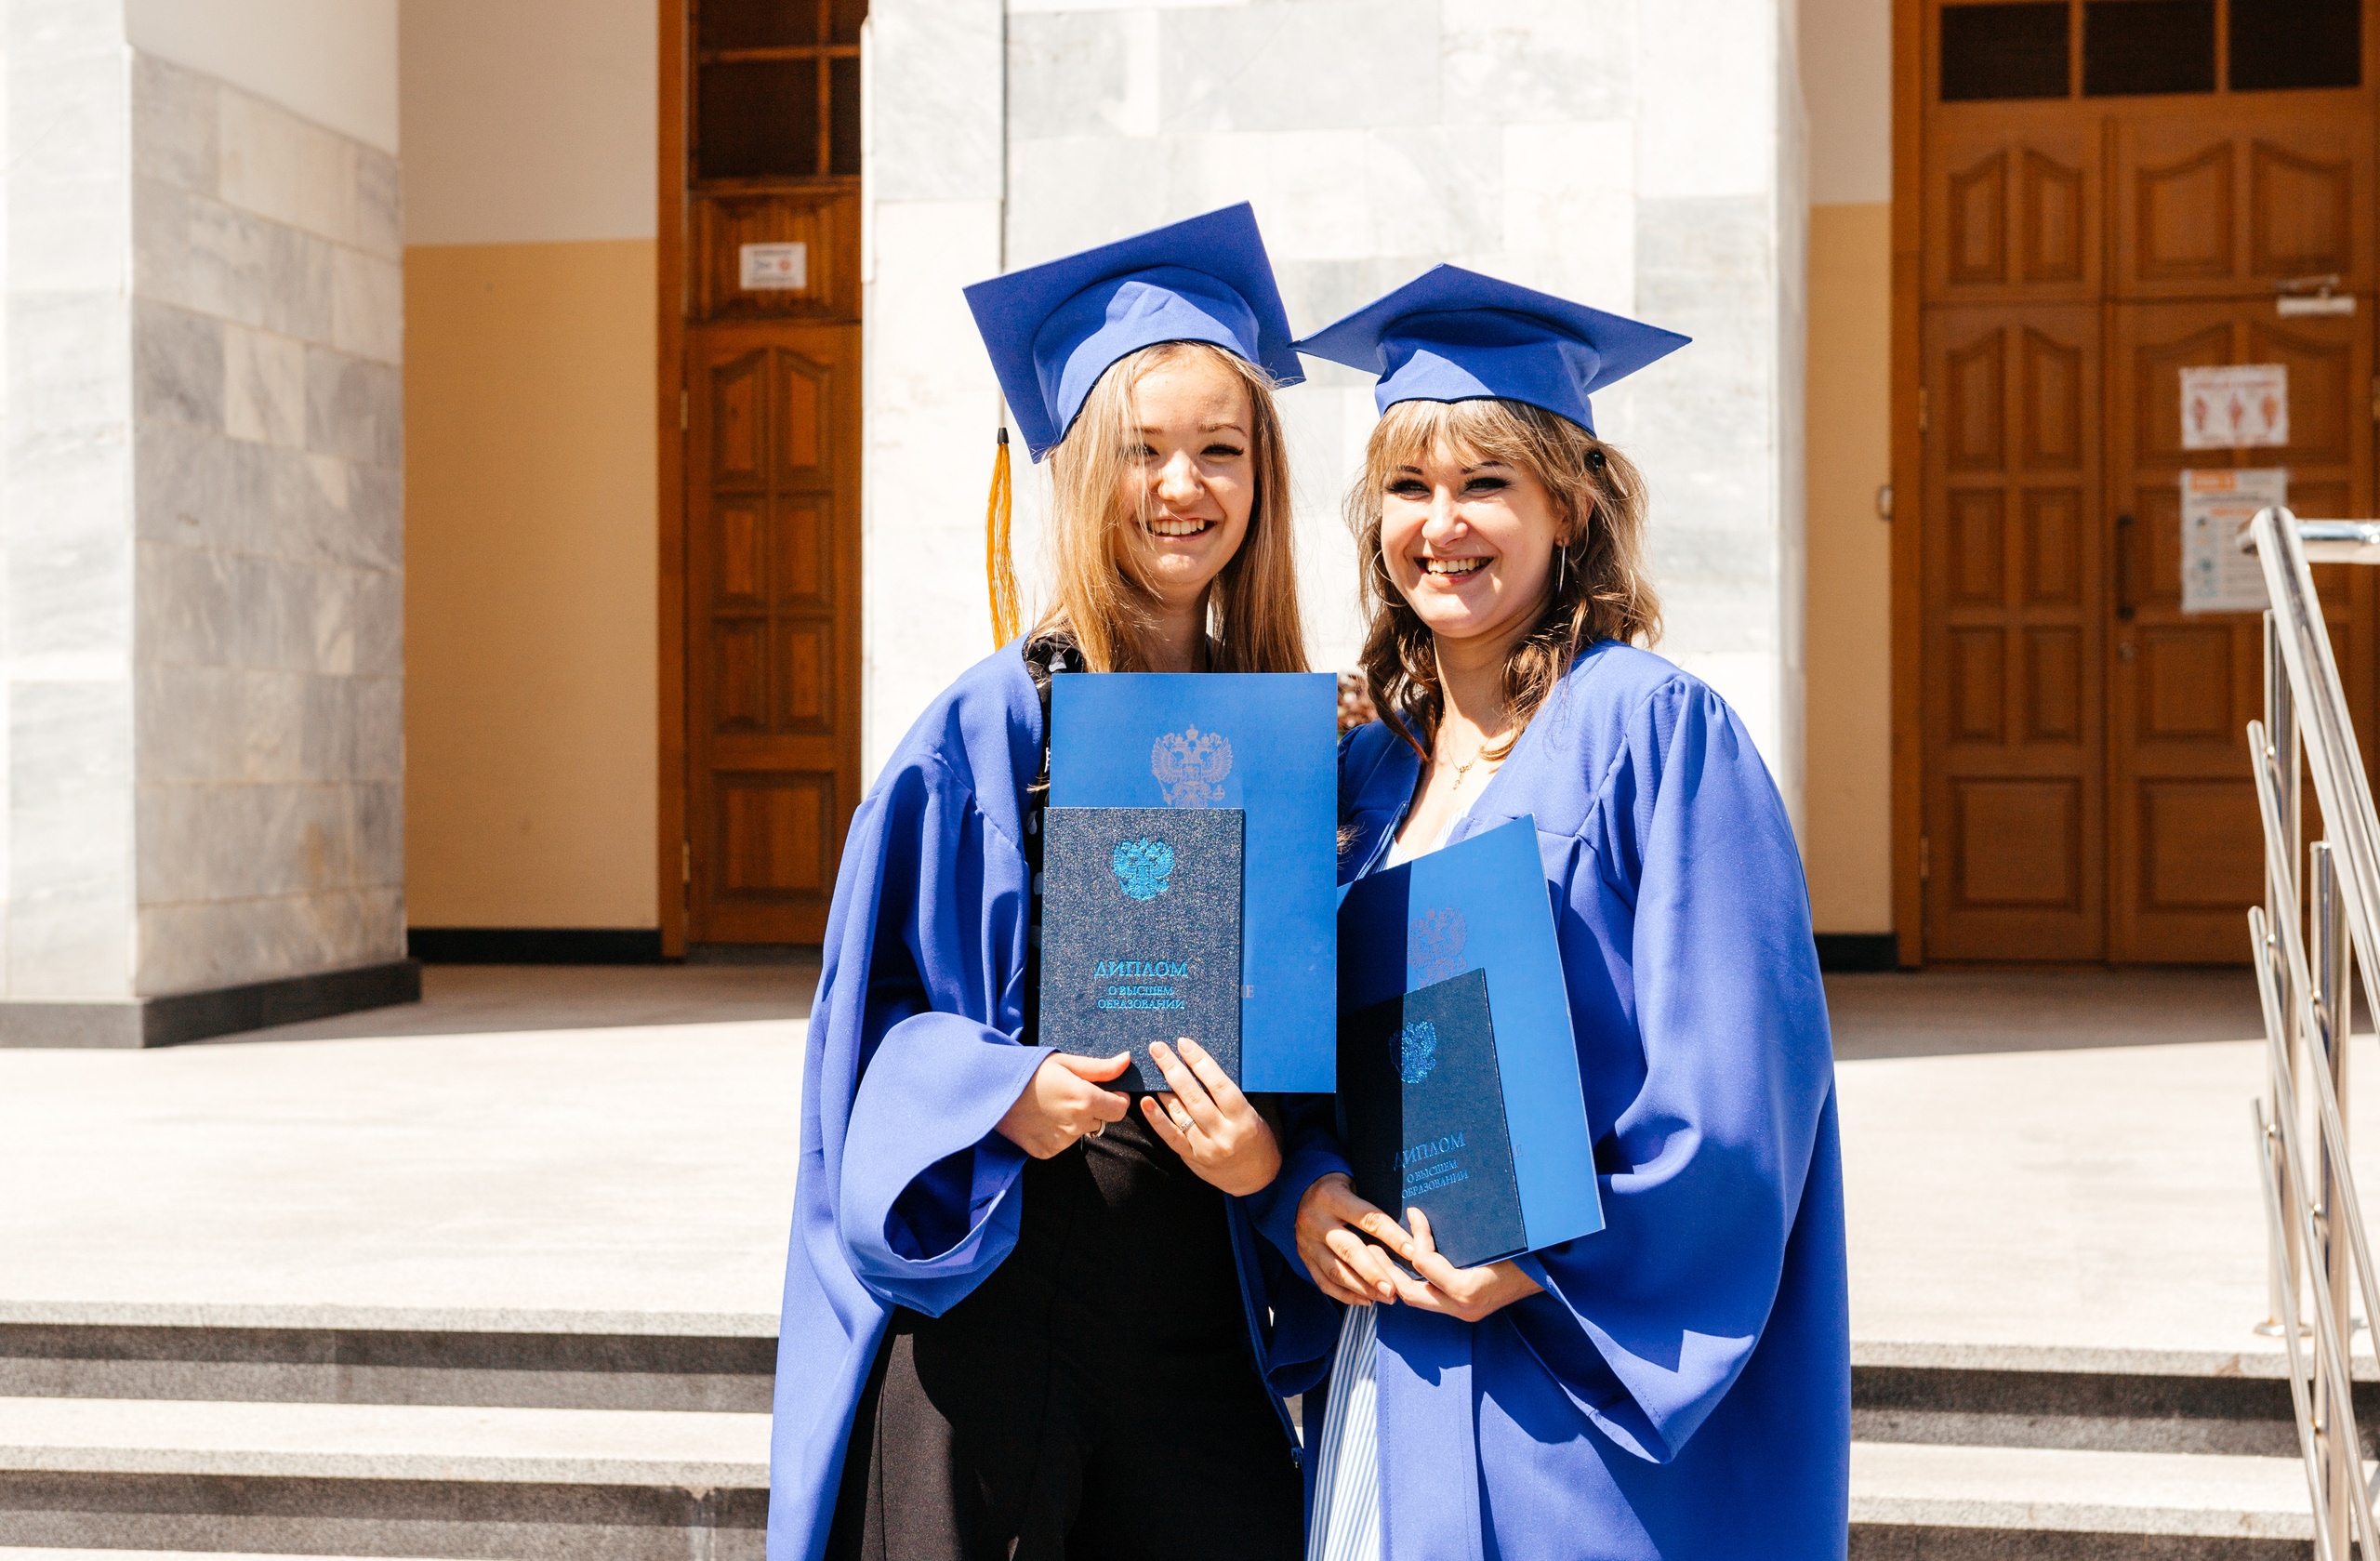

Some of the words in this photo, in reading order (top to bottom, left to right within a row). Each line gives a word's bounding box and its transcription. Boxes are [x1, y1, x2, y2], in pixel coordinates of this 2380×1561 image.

[1093, 960, 1188, 979] ДИПЛОМ
[1107, 986, 1117, 996] О
[1118, 986, 1174, 996] ВЫСШЕМ
[1097, 999, 1185, 1010] ОБРАЗОВАНИИ
[1394, 1131, 1466, 1171] ДИПЛОМ
[1407, 1173, 1415, 1184] О
[1415, 1158, 1458, 1182] ВЫСШЕМ
[1401, 1169, 1469, 1199] ОБРАЗОВАНИИ
